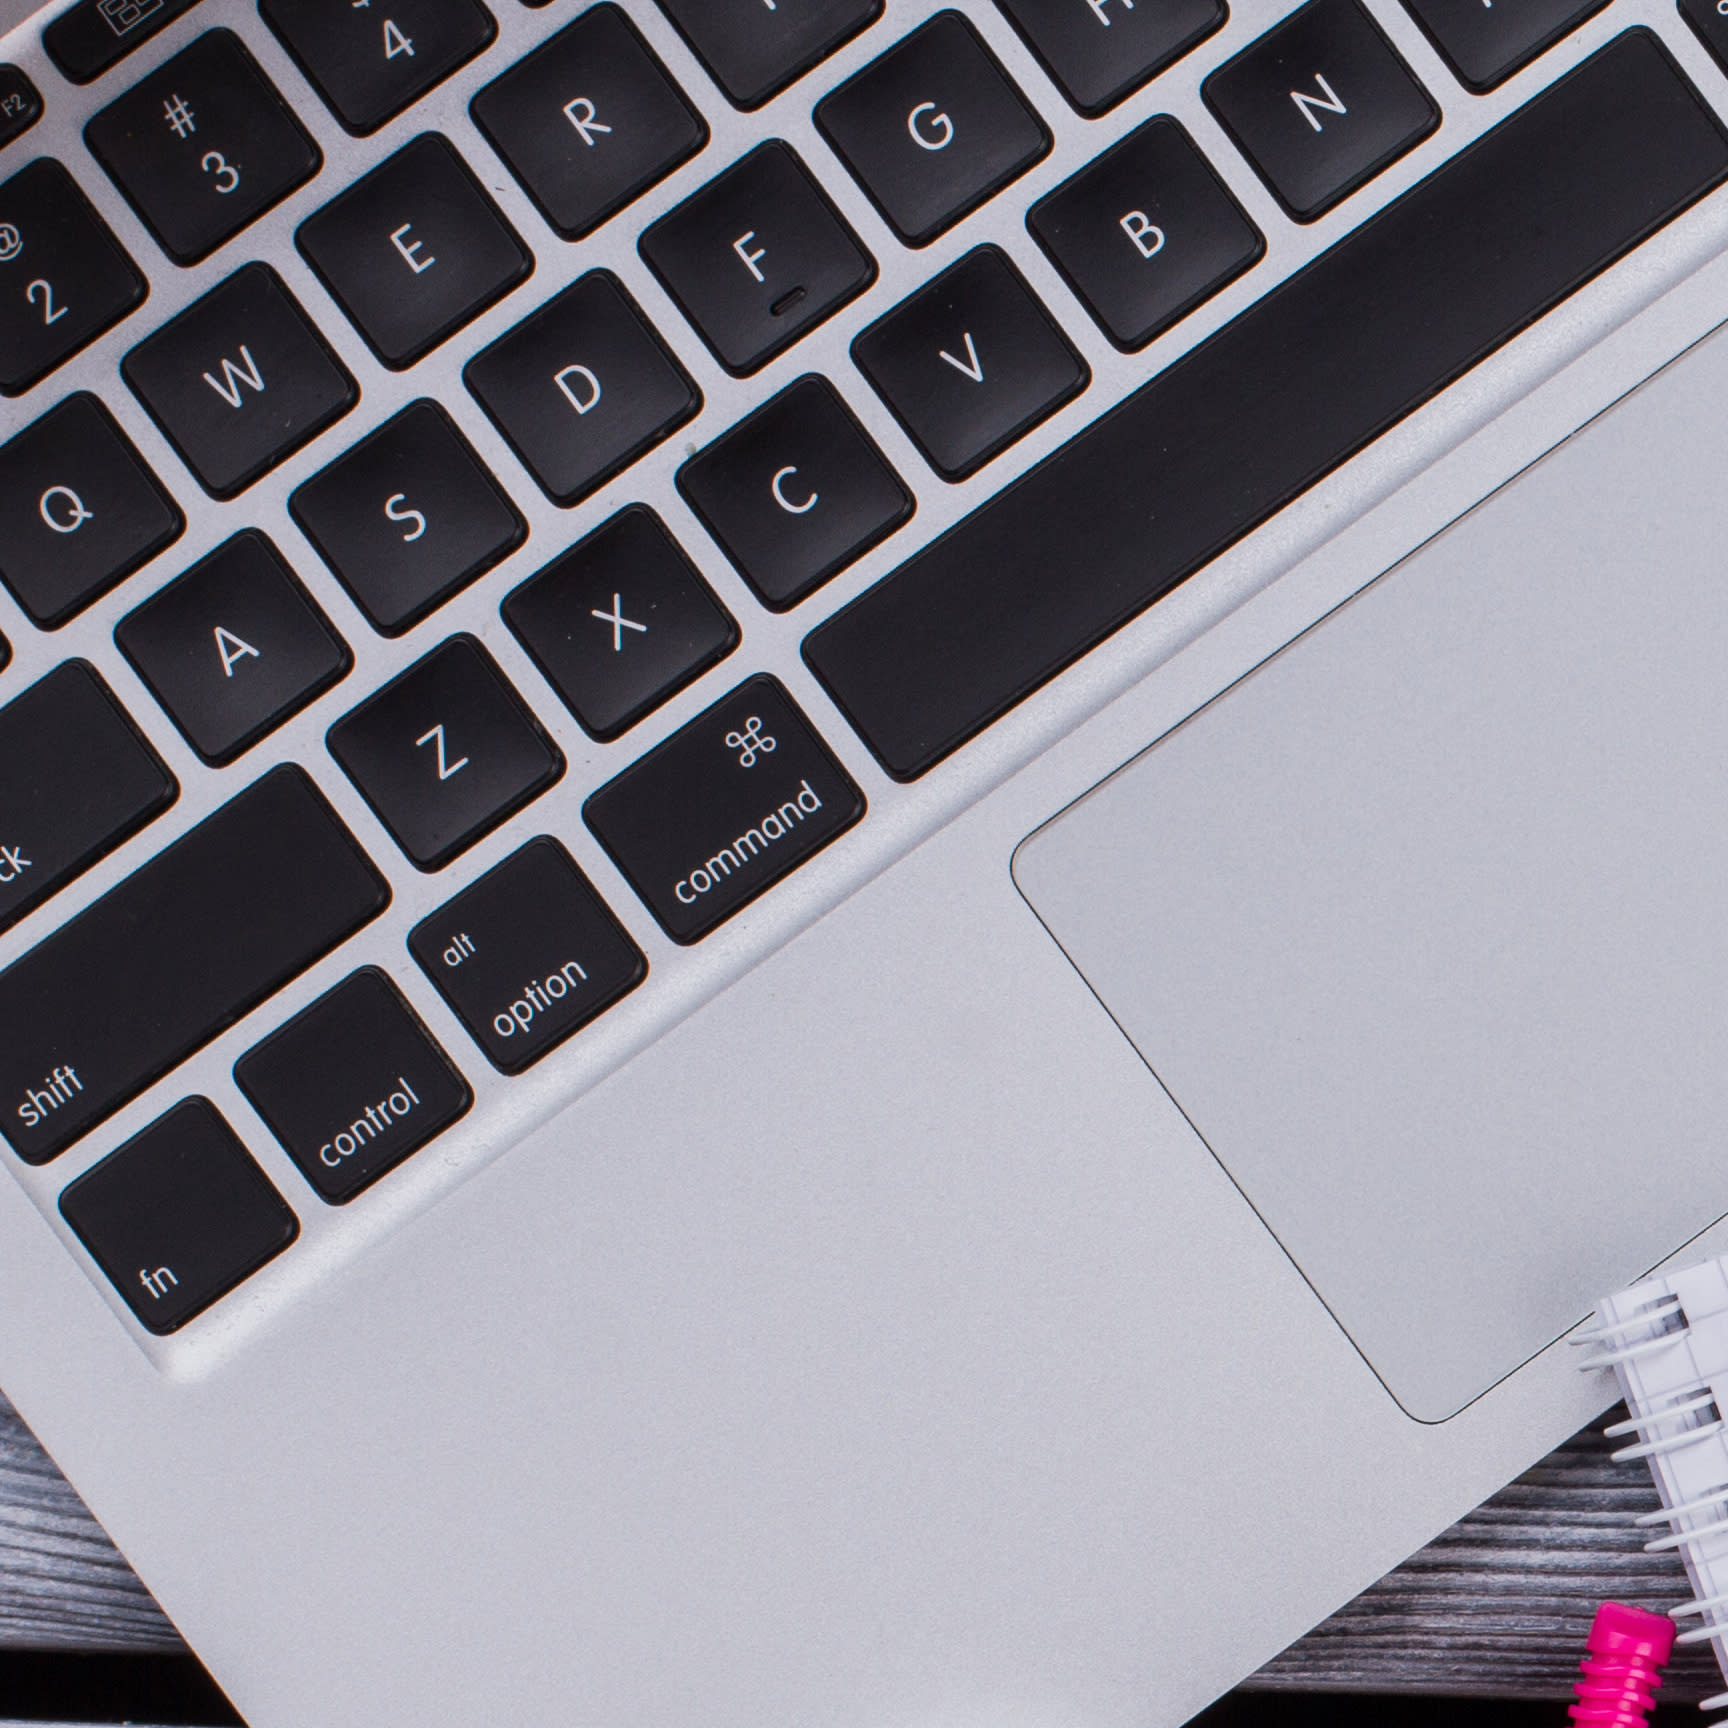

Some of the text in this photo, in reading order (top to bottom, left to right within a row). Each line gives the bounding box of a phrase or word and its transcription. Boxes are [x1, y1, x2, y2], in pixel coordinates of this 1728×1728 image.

[383, 19, 415, 59] 4
[163, 94, 195, 139] #
[563, 97, 612, 146] R
[907, 102, 954, 151] G
[1290, 73, 1347, 132] N
[201, 151, 239, 193] 3
[390, 223, 435, 274] E
[733, 231, 766, 282] F
[1119, 210, 1165, 259] B
[26, 279, 68, 325] 2
[203, 345, 265, 408] W
[939, 332, 984, 382] V
[553, 364, 601, 415] D
[39, 485, 93, 533] Q
[771, 466, 818, 514] C
[385, 493, 426, 542] S
[591, 592, 647, 651] X
[214, 626, 260, 677] A
[415, 724, 469, 780] Z
[675, 779, 822, 904] command
[443, 933, 476, 966] alt
[493, 961, 587, 1037] option
[18, 1065, 83, 1127] shift
[319, 1077, 420, 1167] control
[139, 1267, 178, 1299] fn
